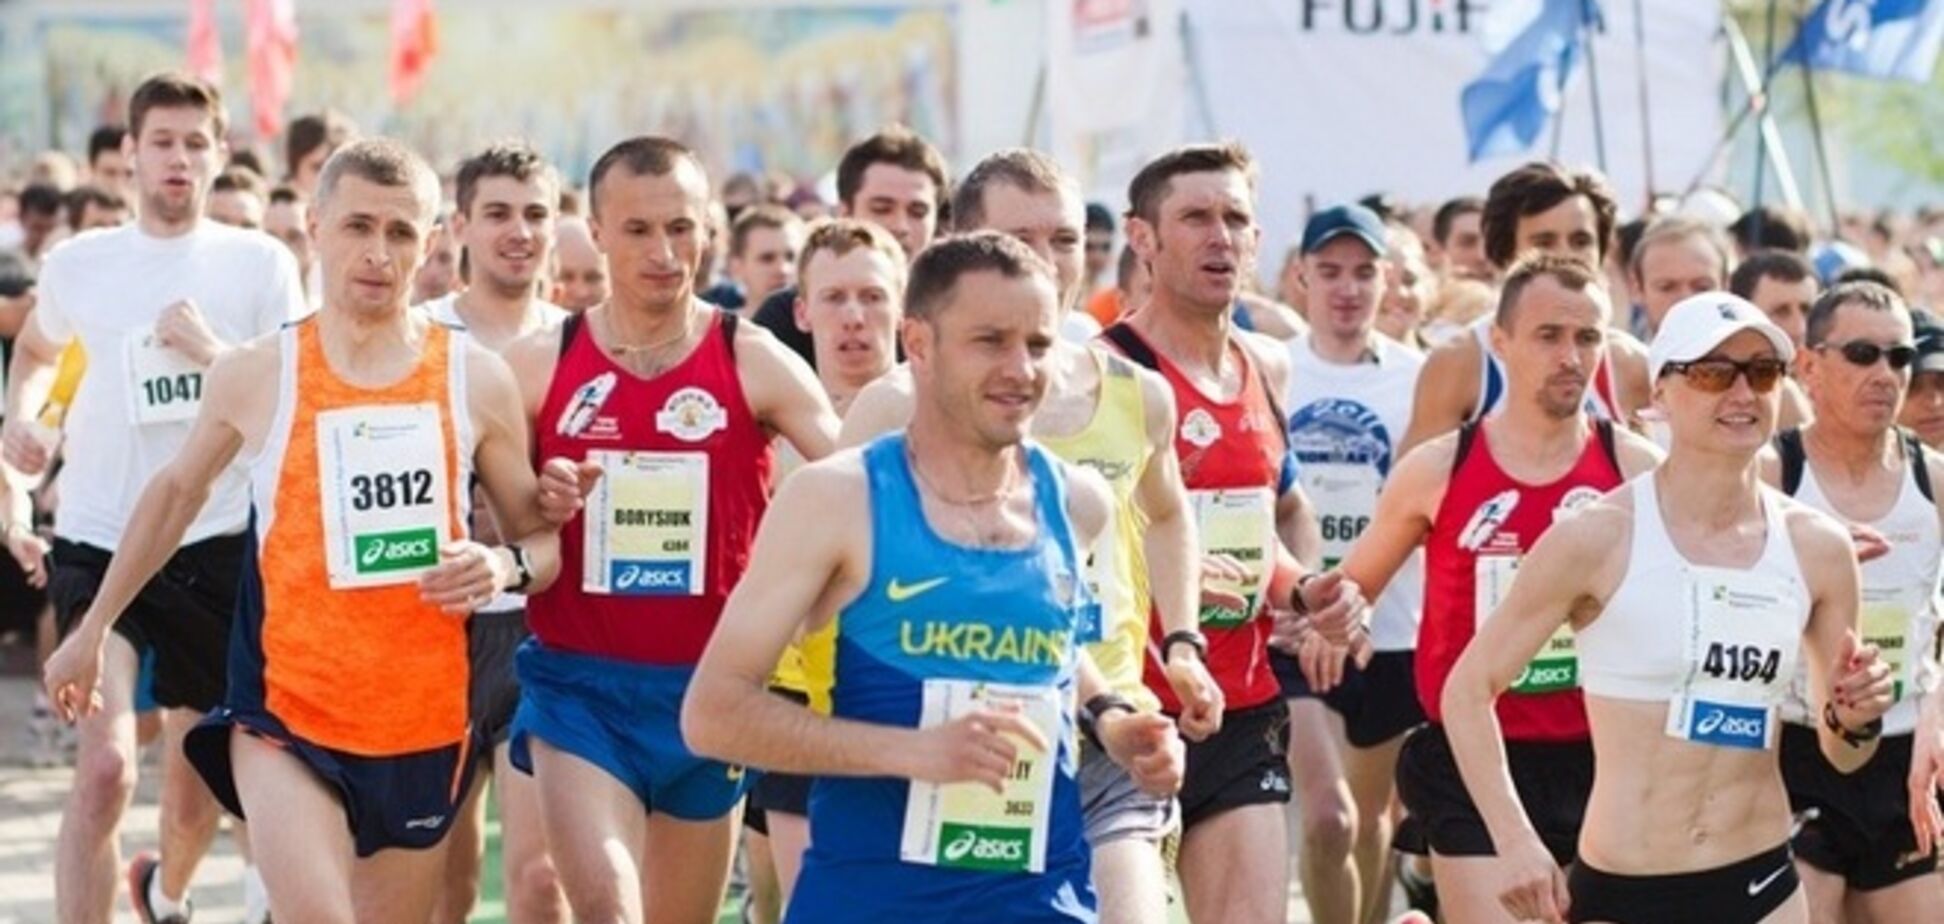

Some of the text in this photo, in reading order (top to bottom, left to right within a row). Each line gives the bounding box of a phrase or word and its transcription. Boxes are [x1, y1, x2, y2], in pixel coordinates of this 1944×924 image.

[142, 371, 202, 406] 1047
[351, 468, 434, 511] 3812
[614, 508, 692, 527] BORYSIUK
[384, 538, 431, 561] asics
[638, 569, 684, 587] asics
[1702, 641, 1782, 685] 4164
[1529, 666, 1572, 686] asics
[1720, 715, 1763, 738] asics
[972, 837, 1023, 860] asics
